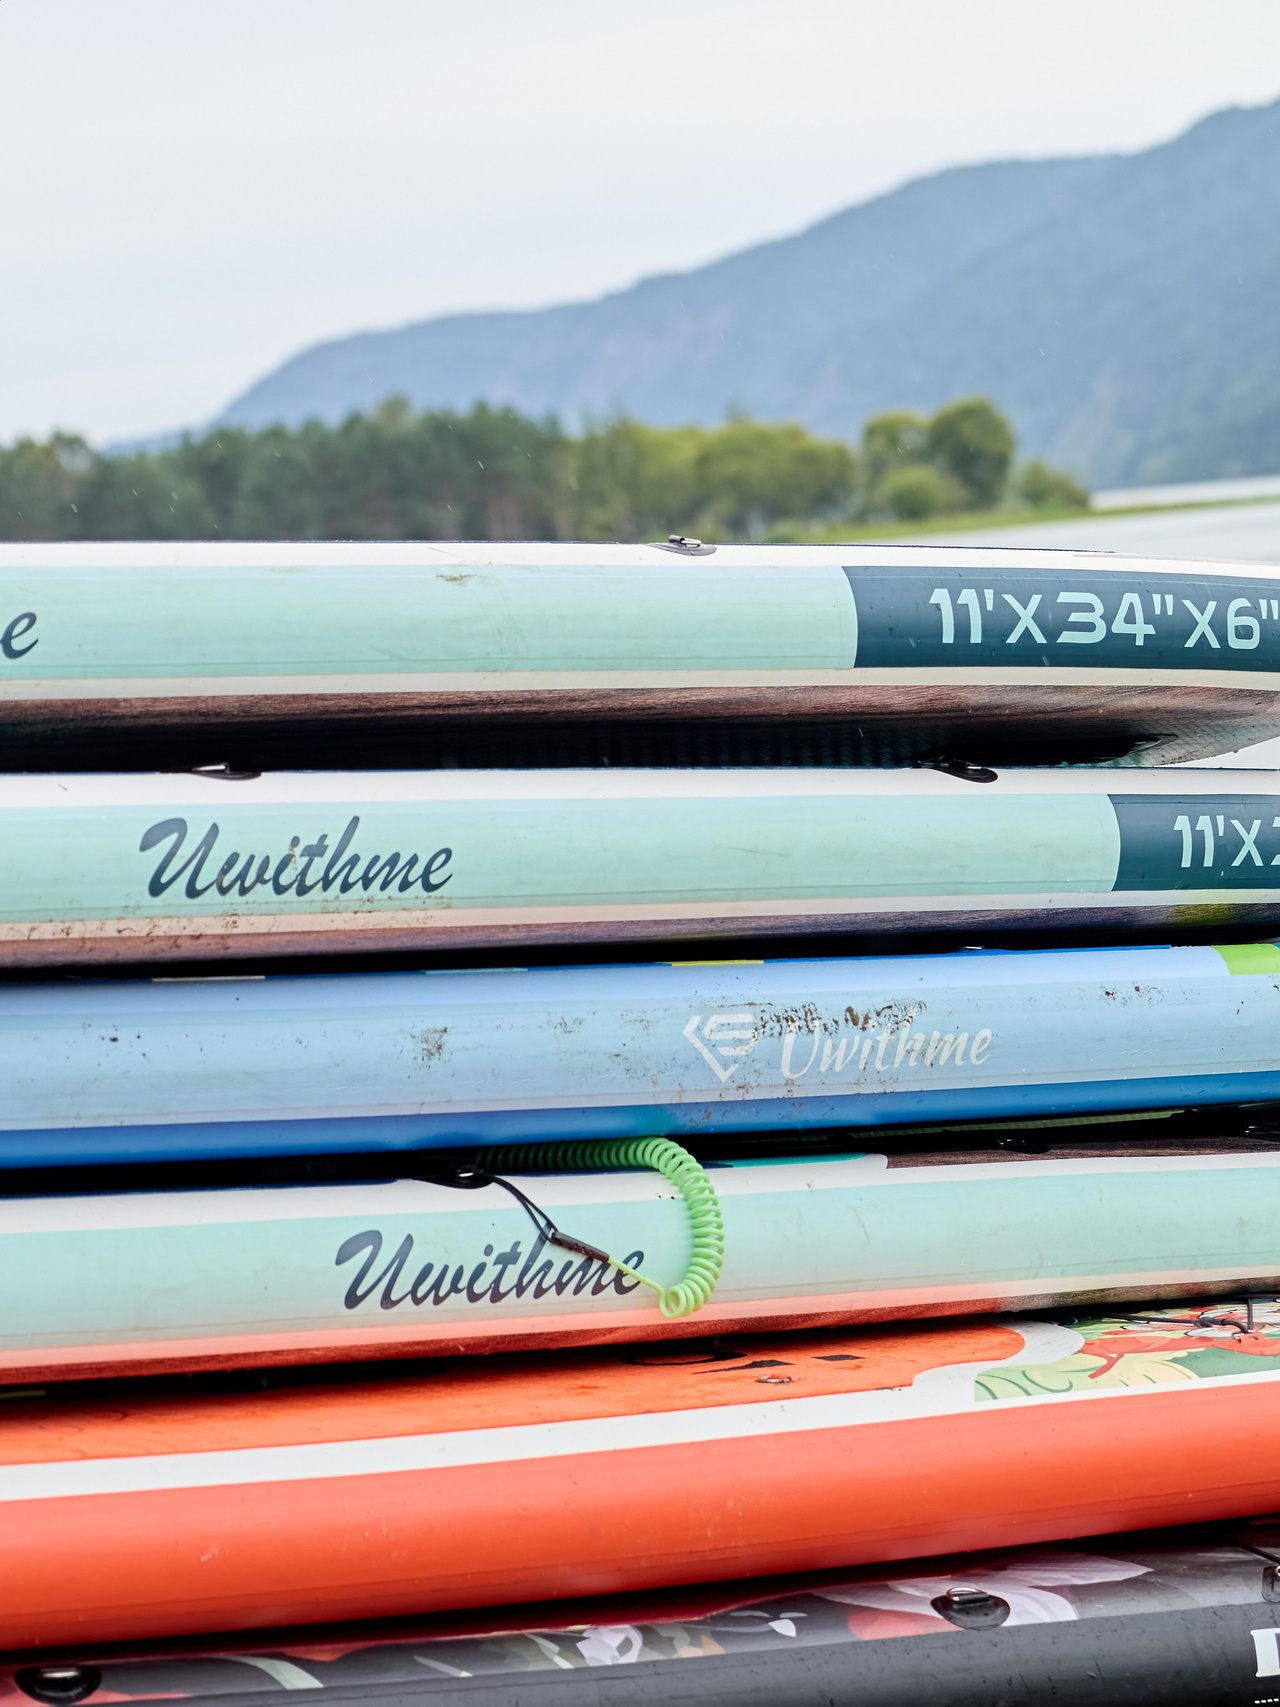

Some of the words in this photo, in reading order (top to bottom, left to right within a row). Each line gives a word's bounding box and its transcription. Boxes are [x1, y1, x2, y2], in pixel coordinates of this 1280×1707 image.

[139, 815, 453, 899] Uwithme
[781, 1003, 993, 1080] Uwithme
[335, 1221, 645, 1310] Uwithme
